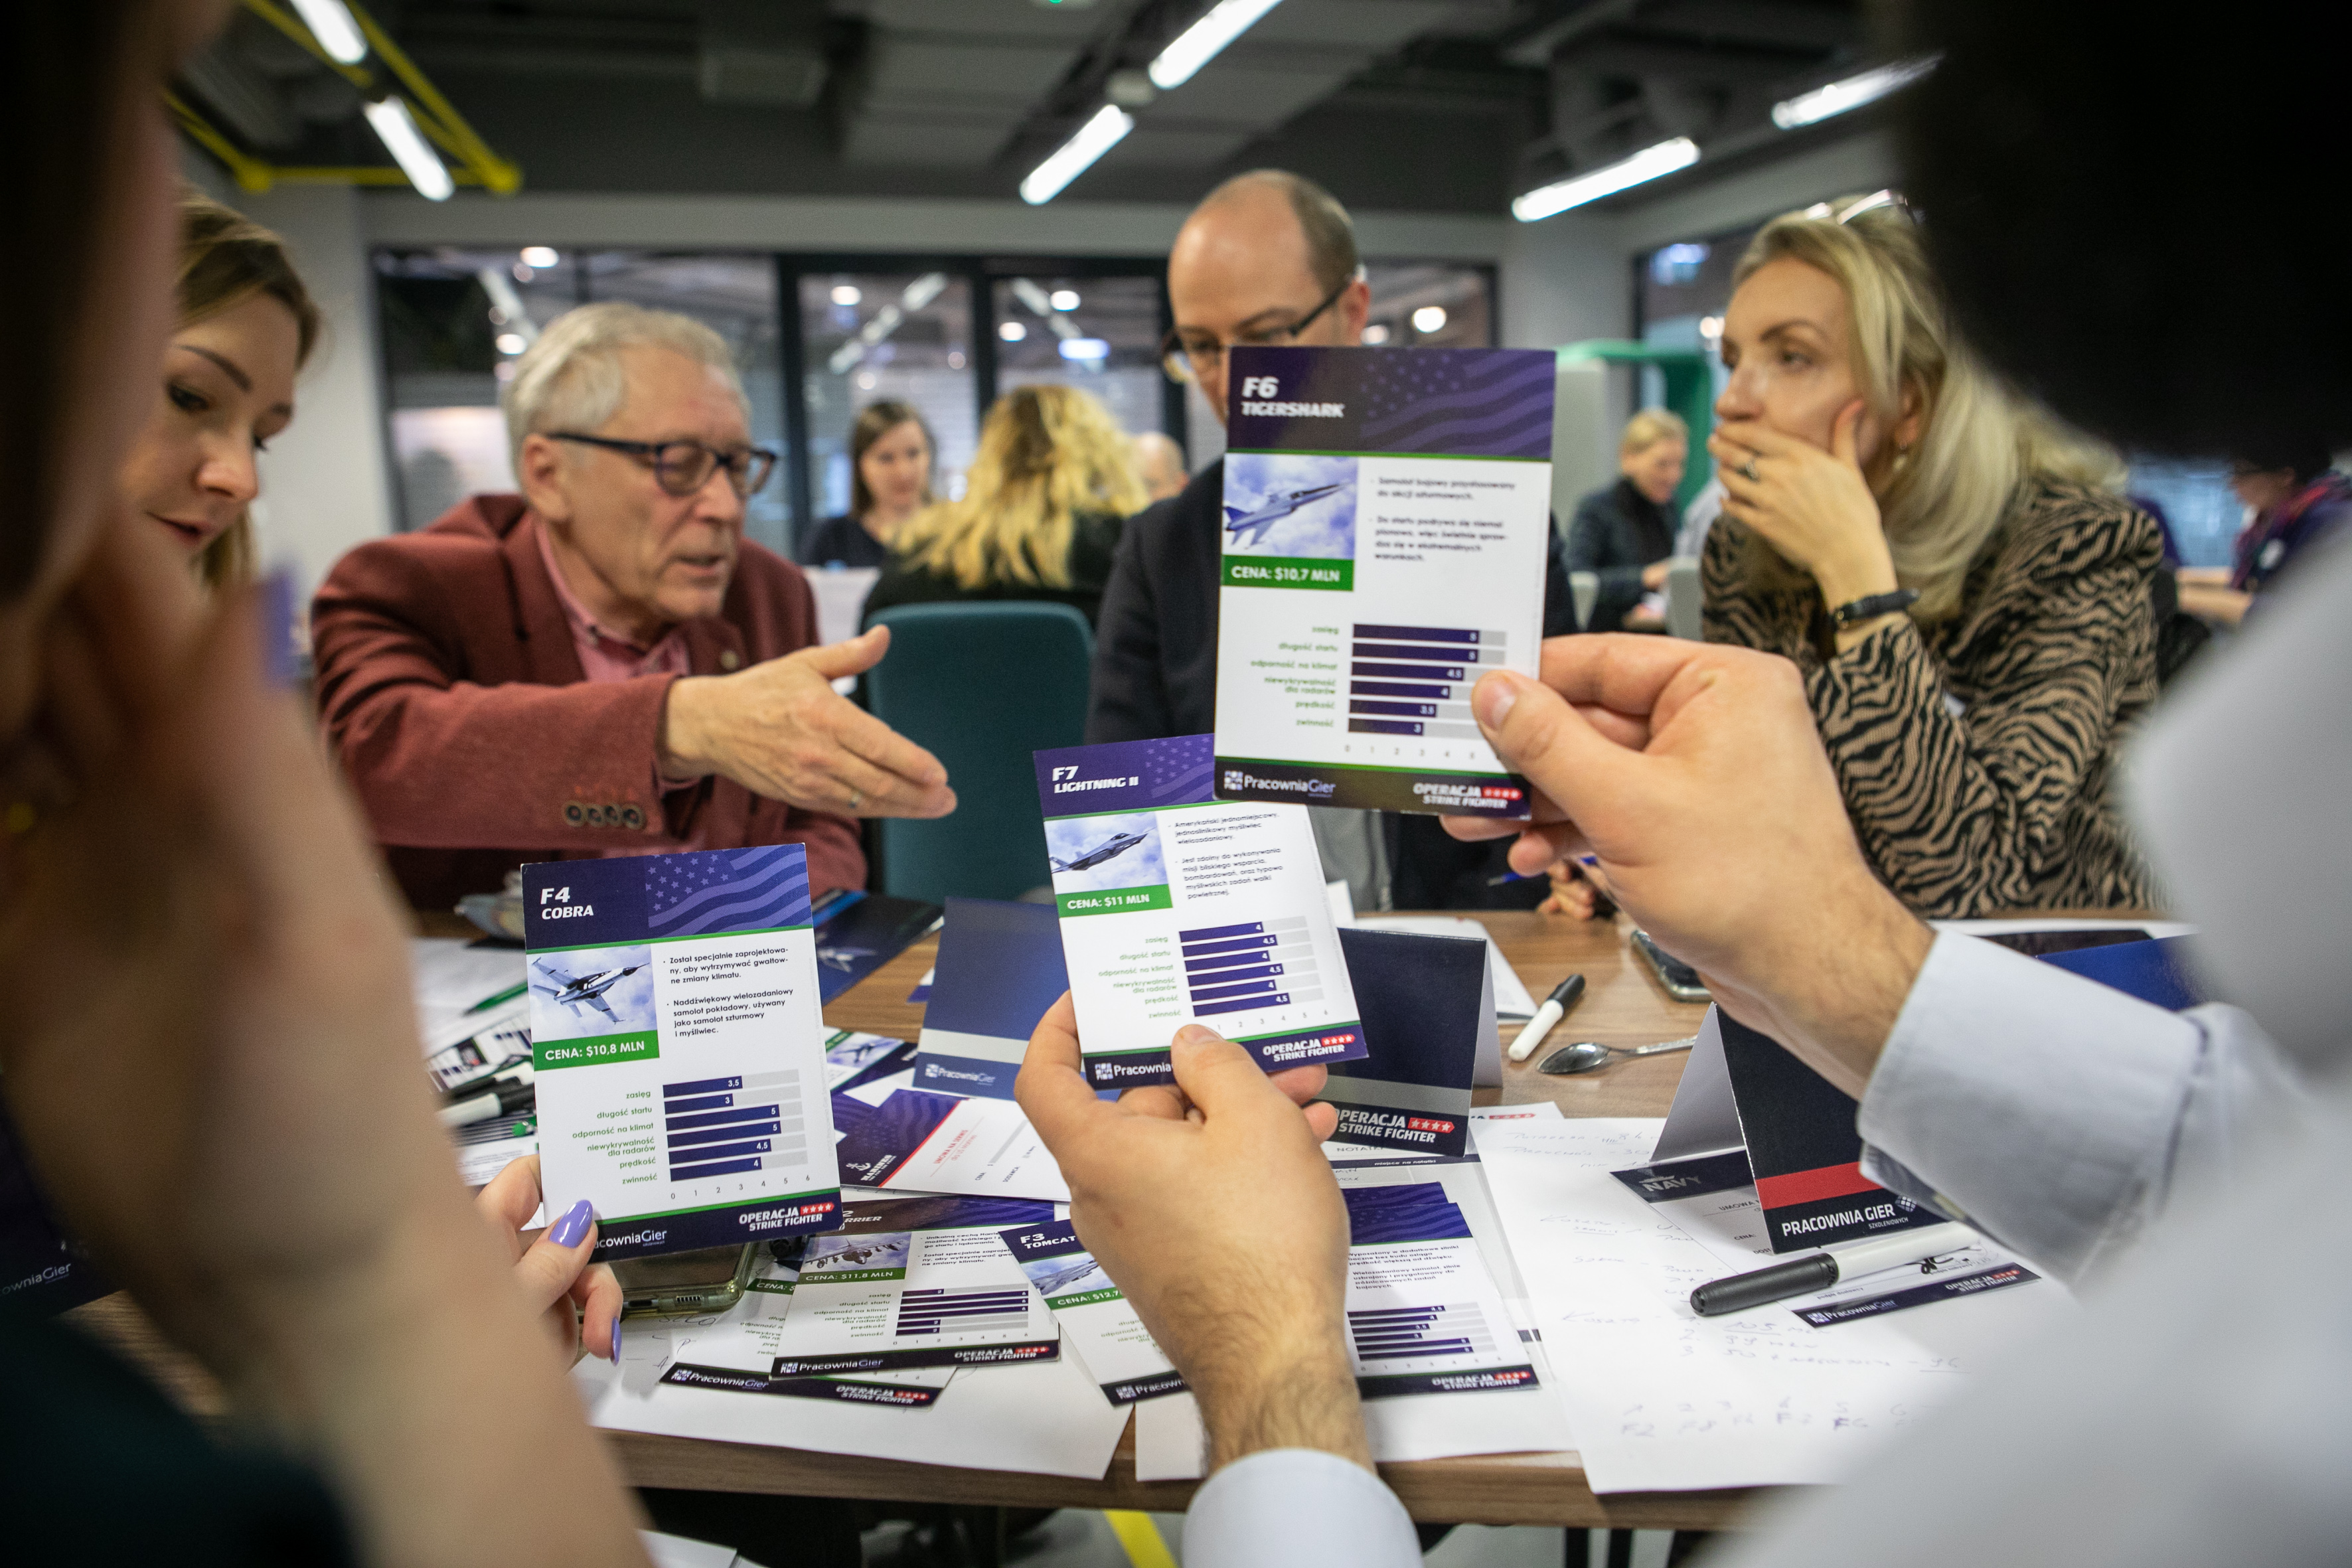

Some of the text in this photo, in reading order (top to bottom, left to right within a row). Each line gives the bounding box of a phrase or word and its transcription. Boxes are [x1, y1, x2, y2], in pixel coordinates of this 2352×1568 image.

[1242, 376, 1279, 398] F6
[1242, 401, 1344, 418] TIGERSHARK
[1231, 565, 1340, 582] CENA: $10,7 MLN
[1052, 765, 1079, 781] F7
[1054, 775, 1139, 793] LIGHTNING II
[1243, 775, 1336, 794] PracowniaGier
[1413, 783, 1481, 798] OPERACJA
[1423, 795, 1508, 809] STRIKE FIGHTER
[540, 886, 570, 905] F4
[1066, 894, 1150, 909] CENA: $11 MLN
[541, 904, 594, 920] COBRA
[669, 947, 788, 964] Został specjalnie zaprojektowa-
[1119, 951, 1149, 961] długość
[700, 959, 751, 972] wytrzymywać
[753, 957, 788, 967] gwałtow-
[1097, 967, 1137, 977] odporność
[711, 971, 742, 980] klimatu.
[673, 988, 793, 1006] Naddźwiękowy wielozadaniowy
[673, 999, 785, 1017] samolot pokładowy, używany
[674, 1012, 765, 1028] jako samolot szturmowy
[679, 1027, 719, 1038] myśliwiec.
[544, 1040, 645, 1061] CENA: $10,8 MLN
[1263, 1038, 1321, 1056] OPERACJA
[1272, 1044, 1345, 1062] STRIKE FIGHTER
[1113, 1063, 1172, 1077] Pracownia
[728, 1079, 740, 1087] 3,5
[625, 1091, 651, 1099] zasięg
[596, 1106, 653, 1119] długość startu
[771, 1107, 776, 1115] 5
[572, 1126, 615, 1138] odporność
[629, 1122, 654, 1132] klimat
[1338, 1123, 1436, 1143] STRIKE FIGHTER
[586, 1136, 655, 1151] niewykrywalność
[622, 1145, 656, 1155] radarów
[756, 1141, 768, 1150] 4,5
[619, 1156, 656, 1170] prędkość
[622, 1172, 657, 1184] zwinność
[1642, 1176, 1701, 1193] NAVY
[1719, 1200, 1753, 1212] UMOWA
[739, 1206, 799, 1225] OPERACJA
[749, 1214, 823, 1231] STRIKE FIGHTER
[1781, 1203, 1896, 1237] PRACOWNIA GIER
[1868, 1216, 1909, 1229] SZKOLENIOWYCH
[1020, 1233, 1046, 1245] F3
[1024, 1235, 1076, 1249] TOMCAT
[756, 1283, 786, 1291] CENA:
[1057, 1295, 1091, 1305] CENA:
[1824, 1300, 1897, 1319] PracowniaGier
[954, 1348, 1014, 1358] OPERACJA
[799, 1360, 883, 1371] PracowniaGier
[690, 1373, 769, 1388] PracowniaGier
[836, 1385, 895, 1397] OPERACJA
